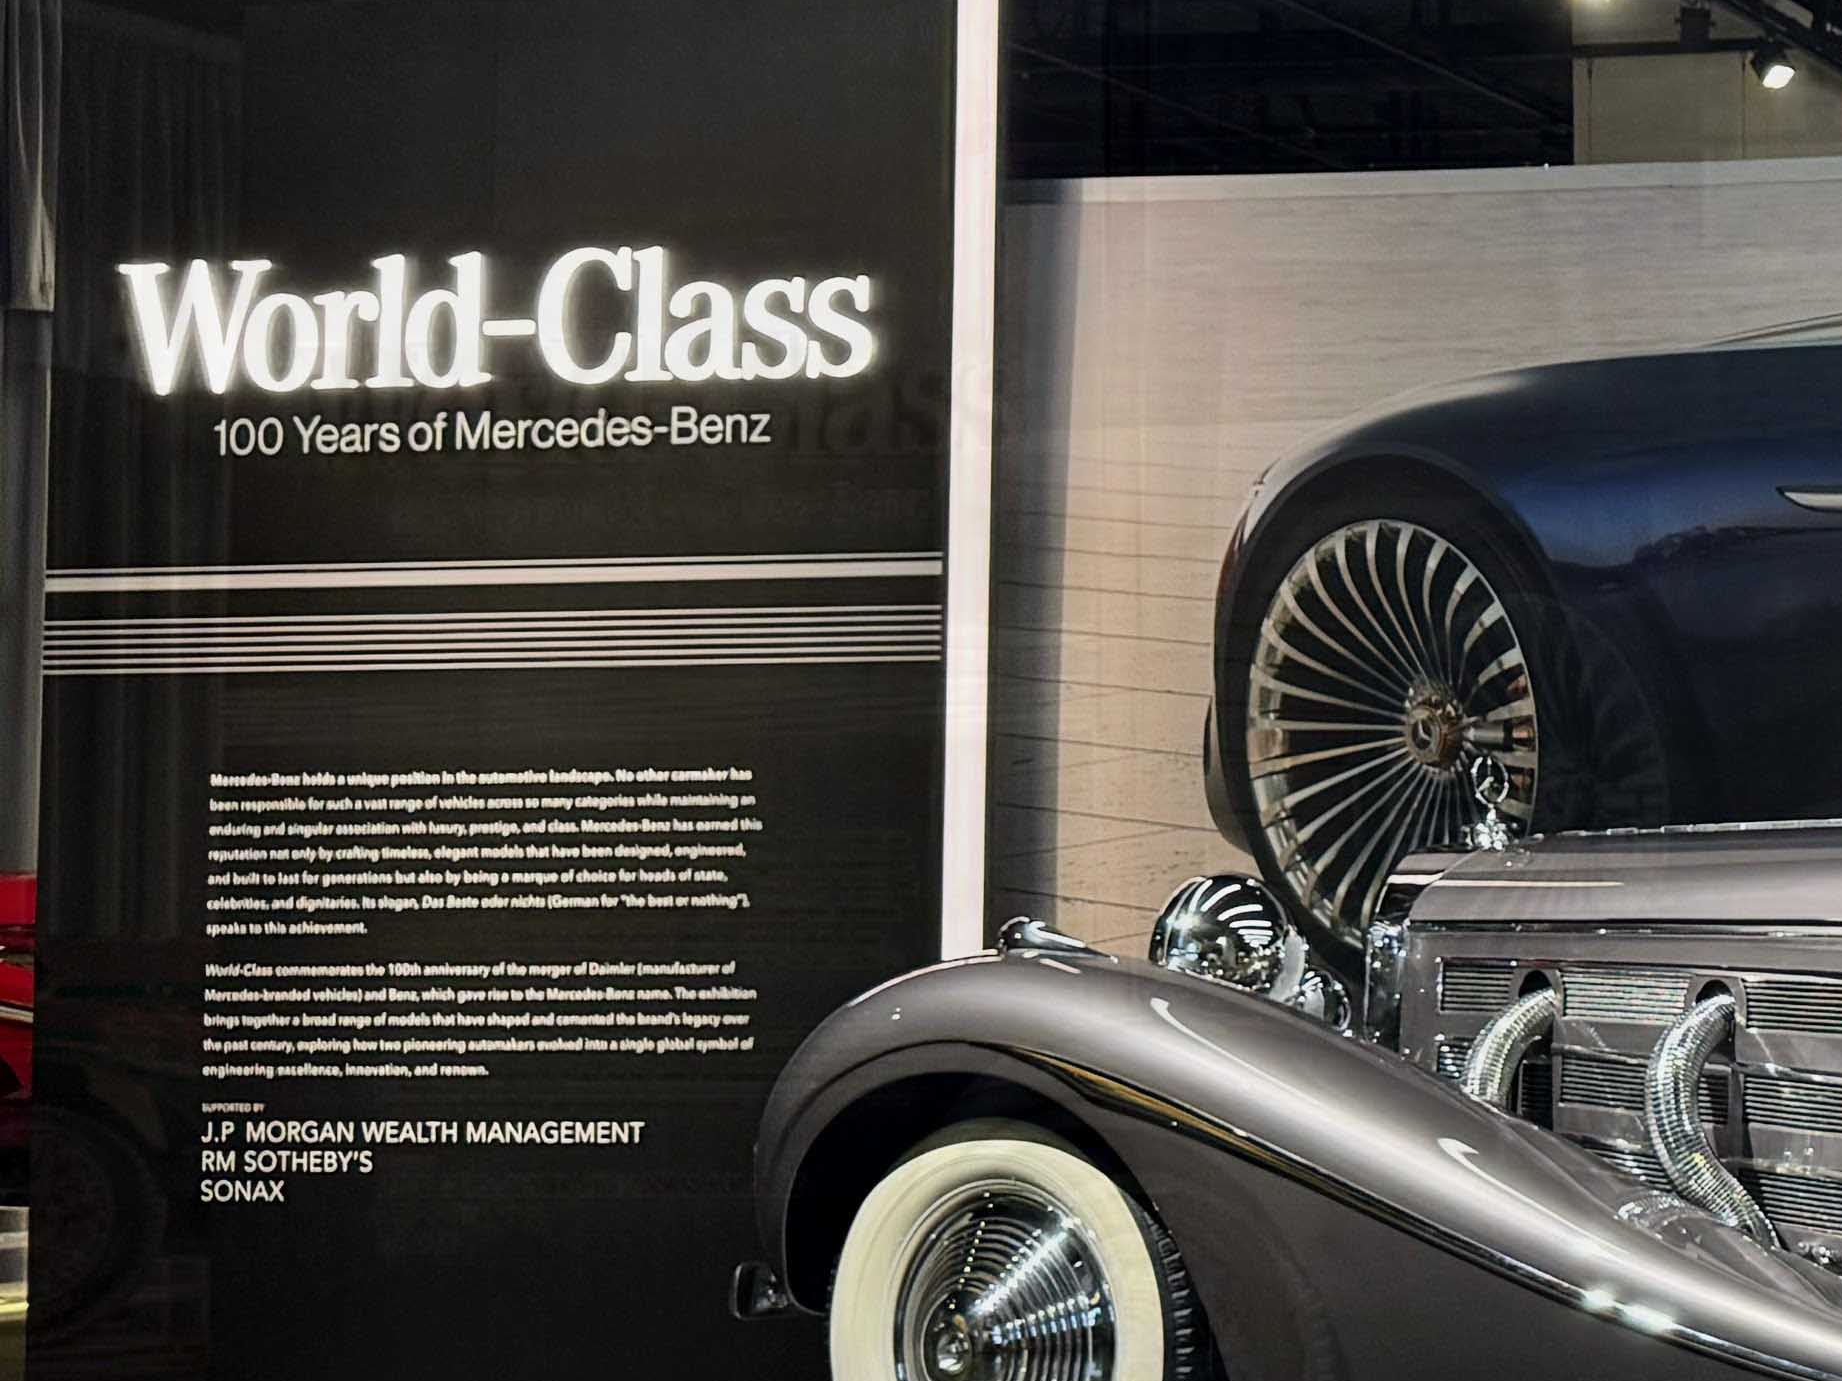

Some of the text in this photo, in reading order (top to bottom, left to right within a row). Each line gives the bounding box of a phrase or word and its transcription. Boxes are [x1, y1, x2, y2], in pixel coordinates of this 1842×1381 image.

[117, 245, 876, 397] World-Class
[214, 406, 772, 457] 100 Years of Mercedes-Benz
[208, 822, 262, 839] enduring
[263, 821, 286, 836] and
[287, 821, 334, 839] singular
[335, 821, 401, 836] association
[401, 820, 428, 835] with
[522, 819, 547, 834] and
[672, 818, 695, 832] has
[695, 817, 739, 832] earned
[739, 817, 763, 831] this
[208, 848, 268, 863] reputation
[269, 848, 290, 860] not
[291, 846, 317, 863] only
[317, 846, 334, 863] by
[335, 845, 381, 863] crafting
[433, 845, 480, 862] elegant
[480, 843, 525, 859] models
[525, 843, 550, 859] that
[551, 843, 581, 858] have
[581, 843, 614, 858] been
[207, 871, 231, 885] and
[232, 871, 260, 885] built
[262, 873, 276, 885] to
[277, 871, 300, 885] last
[301, 870, 320, 885] for
[321, 870, 393, 888] generations
[394, 869, 416, 885] but
[417, 869, 444, 884] also
[444, 869, 462, 887] by
[462, 869, 500, 887] being
[511, 872, 559, 886] marque
[560, 868, 575, 884] of
[575, 868, 617, 883] choice
[618, 867, 637, 883] for
[638, 868, 677, 883] heads
[677, 867, 692, 882] of
[271, 896, 294, 910] and
[361, 896, 377, 909] Its
[421, 894, 445, 909] Das
[445, 894, 480, 909] Beste
[480, 894, 510, 909] oder
[510, 894, 546, 909] nichts
[600, 893, 619, 908] for
[647, 893, 674, 908] best
[675, 896, 690, 907] or
[206, 921, 247, 938] speaks
[248, 923, 263, 935] to
[264, 920, 287, 935] this
[275, 964, 365, 977] commemorates
[365, 962, 386, 977] the
[388, 962, 422, 977] 100th
[423, 962, 491, 979] anniversary
[491, 961, 506, 976] of
[506, 962, 528, 976] the
[528, 965, 572, 979] merger
[573, 961, 588, 976] of
[588, 961, 636, 976] Daimler
[721, 960, 736, 975] of
[363, 987, 387, 1002] and
[421, 986, 456, 1002] which
[456, 990, 487, 1005] gave
[487, 987, 510, 1001] rise
[510, 989, 524, 1001] to
[524, 987, 545, 1001] the
[674, 986, 697, 1000] The
[203, 1013, 240, 1030] brings
[241, 1013, 291, 1030] together
[302, 1012, 337, 1027] broad
[338, 1015, 372, 1030] range
[373, 1011, 387, 1027] of
[387, 1011, 432, 1027] models
[431, 1011, 456, 1027] that
[456, 1011, 486, 1027] have
[486, 1011, 531, 1029] shaped
[531, 1011, 555, 1026] and
[615, 1012, 636, 1026] the
[636, 1011, 681, 1026] brand's
[682, 1011, 722, 1029] legacy
[722, 1014, 750, 1025] over
[203, 1037, 222, 1052] the
[223, 1039, 249, 1054] past
[296, 1037, 352, 1054] exploring
[352, 1037, 378, 1052] how
[379, 1039, 402, 1052] two
[402, 1037, 467, 1055] pioneering
[584, 1037, 609, 1051] into
[619, 1036, 656, 1054] single
[656, 1036, 695, 1054] global
[695, 1036, 739, 1054] symbol
[740, 1036, 754, 1051] of
[202, 1063, 275, 1079] engineering
[413, 1062, 438, 1077] and
[201, 1121, 646, 1145] J.P MORGAN WEALTH MANAGEMENT
[201, 1150, 374, 1174] RM SOTHEBY'S
[200, 1179, 286, 1203] SONAX
